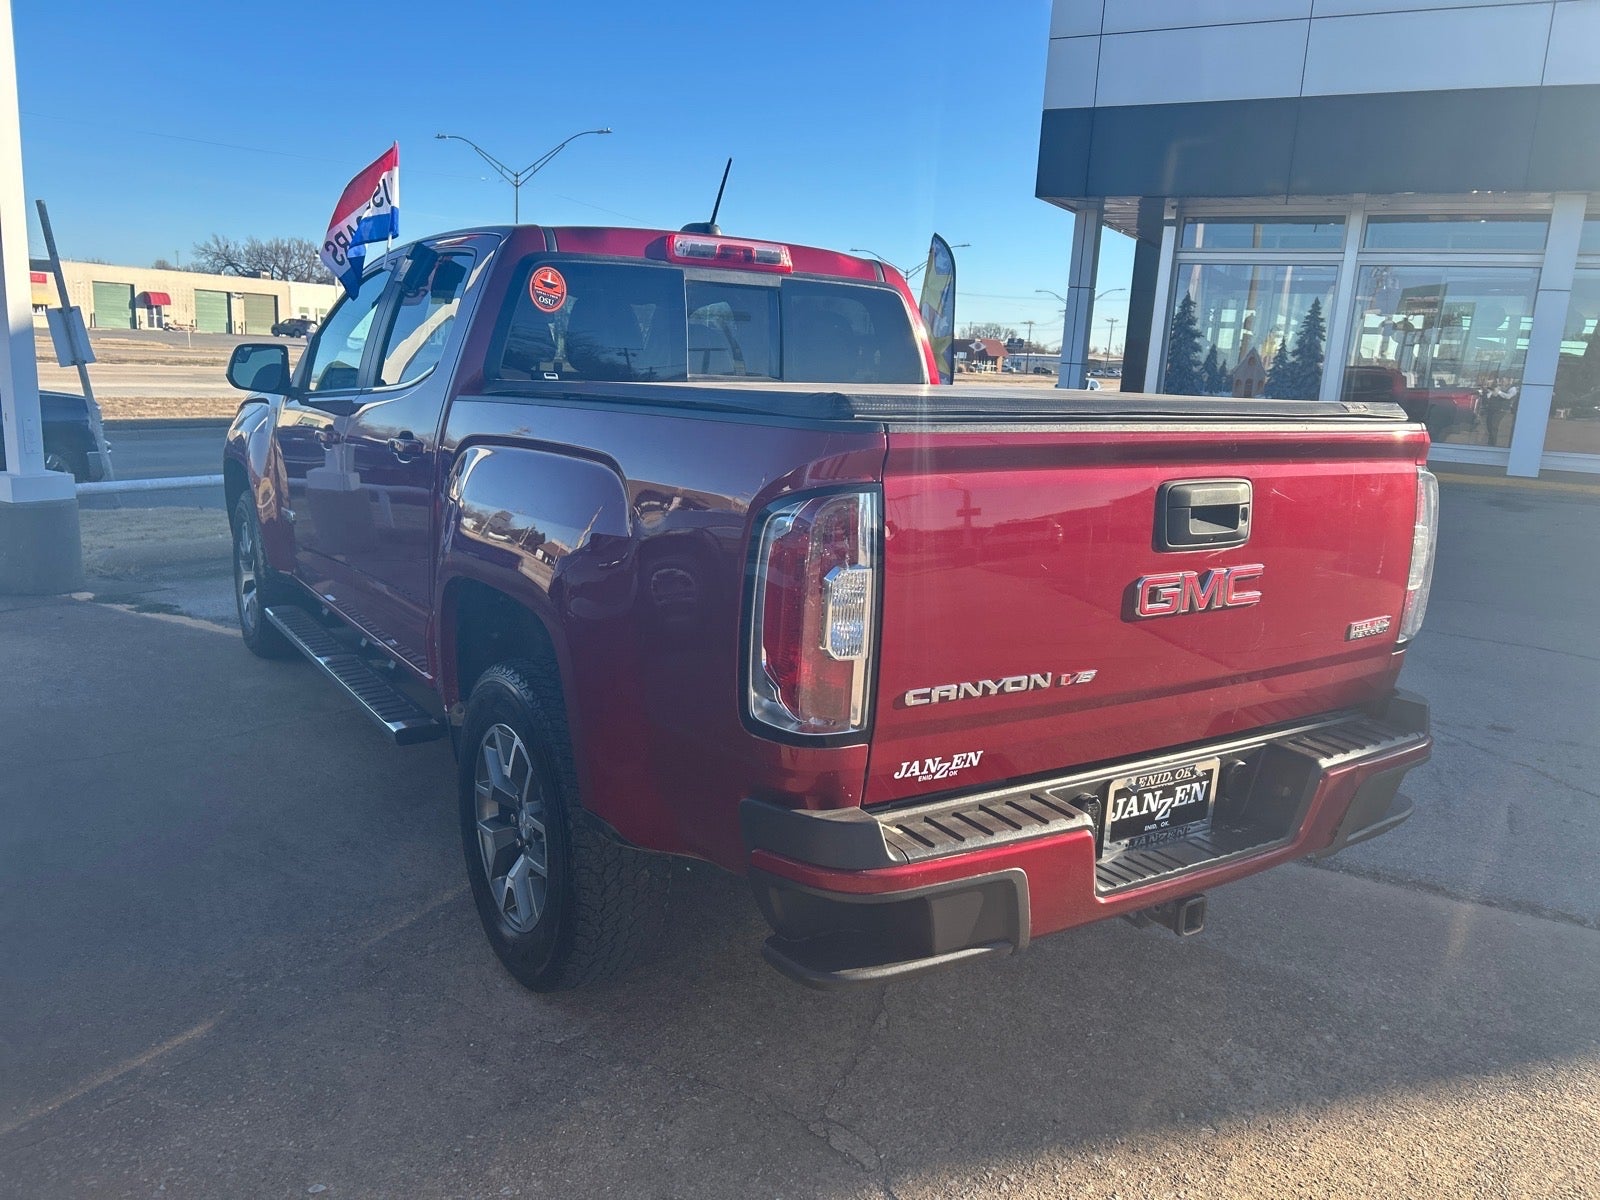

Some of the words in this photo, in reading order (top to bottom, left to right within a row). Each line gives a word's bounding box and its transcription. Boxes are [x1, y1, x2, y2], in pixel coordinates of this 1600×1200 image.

[538, 295, 555, 306] OSU
[1136, 563, 1265, 617] GMC
[905, 671, 1052, 707] CANYON
[893, 750, 984, 780] JANZEN
[917, 774, 933, 783] ENID
[948, 769, 959, 777] OK
[1175, 766, 1194, 780] OK
[1111, 780, 1210, 822] JANZEN
